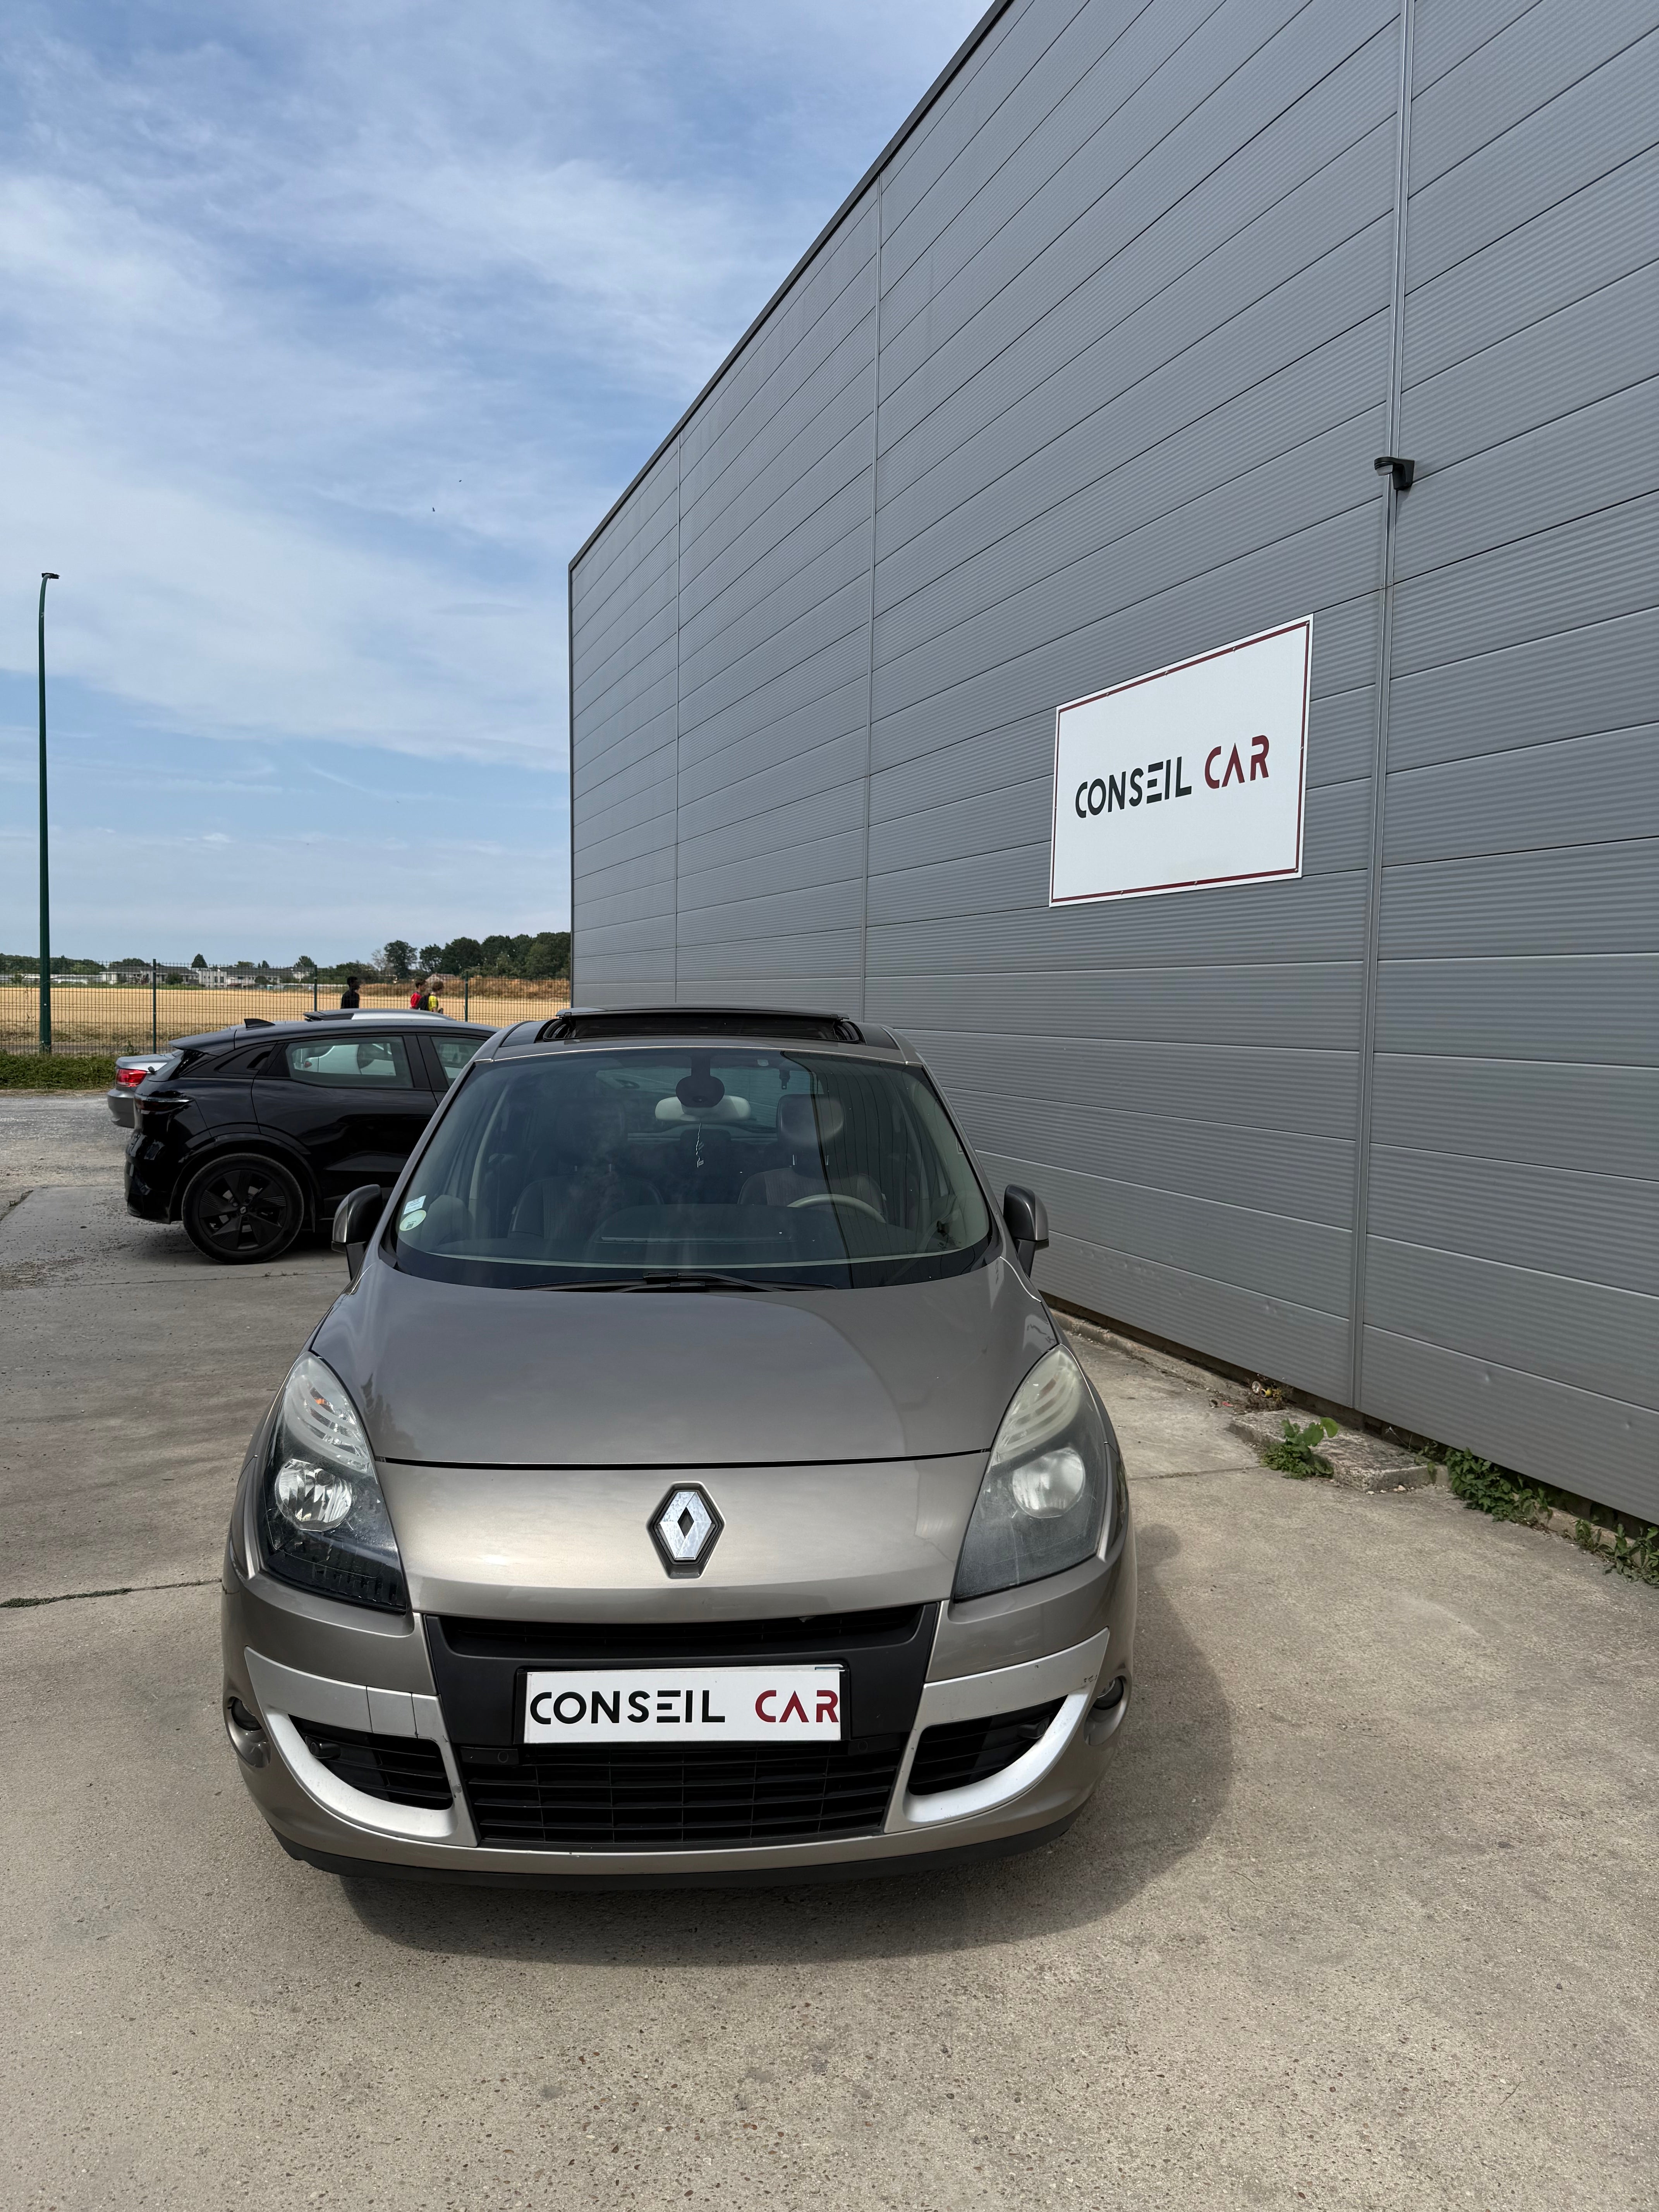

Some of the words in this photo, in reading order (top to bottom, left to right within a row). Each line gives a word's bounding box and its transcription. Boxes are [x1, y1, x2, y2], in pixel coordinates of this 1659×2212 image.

[1075, 756, 1192, 818] CONSEIL
[1204, 735, 1269, 789] CAR
[530, 1690, 725, 1725] CONSEIL
[755, 1690, 839, 1723] CAR
